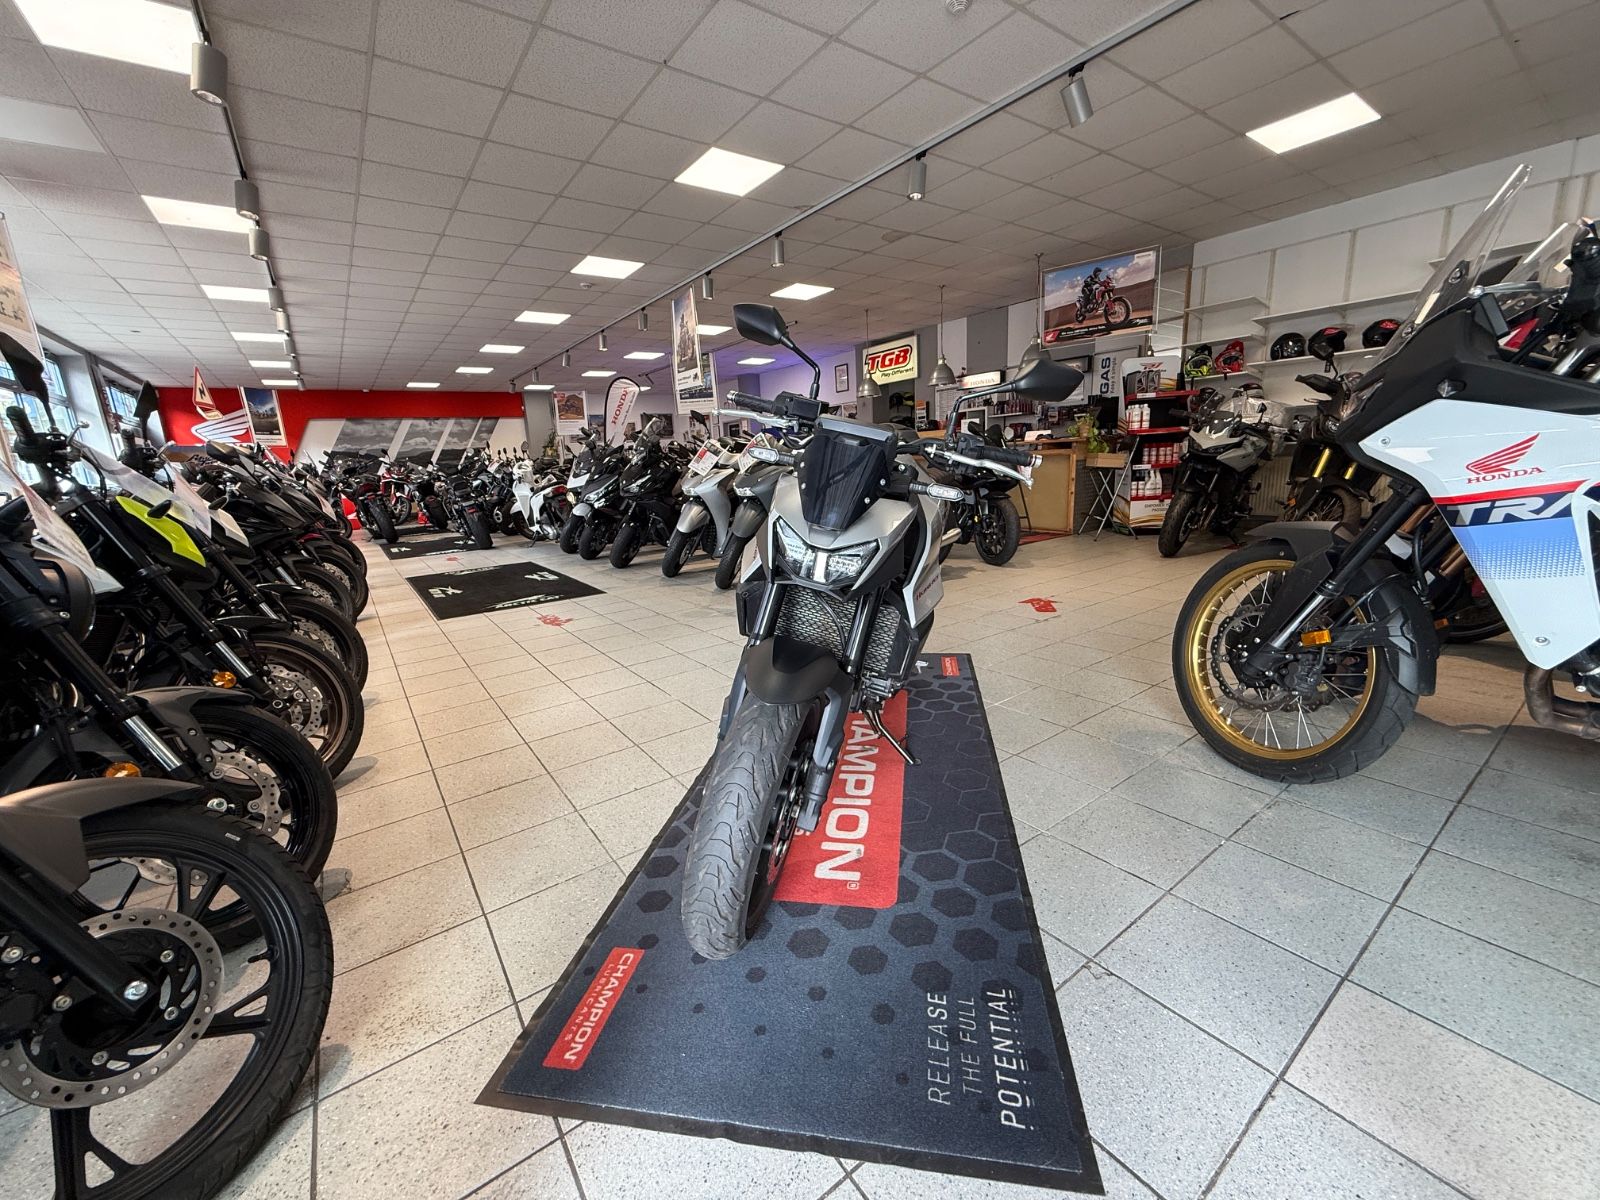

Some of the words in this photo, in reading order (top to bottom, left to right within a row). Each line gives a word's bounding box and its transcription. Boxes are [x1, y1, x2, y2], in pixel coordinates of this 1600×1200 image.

[868, 347, 910, 371] TGB
[1100, 356, 1111, 394] GAS
[1466, 466, 1546, 484] HONDA
[813, 702, 885, 885] AMPION
[563, 952, 634, 1061] CHAMPION
[564, 964, 616, 1041] LUBRICANTS
[957, 997, 978, 1044] FULL
[927, 992, 951, 1105] RELEASE
[961, 1052, 983, 1094] THE
[986, 989, 1026, 1130] POTENTIAL
